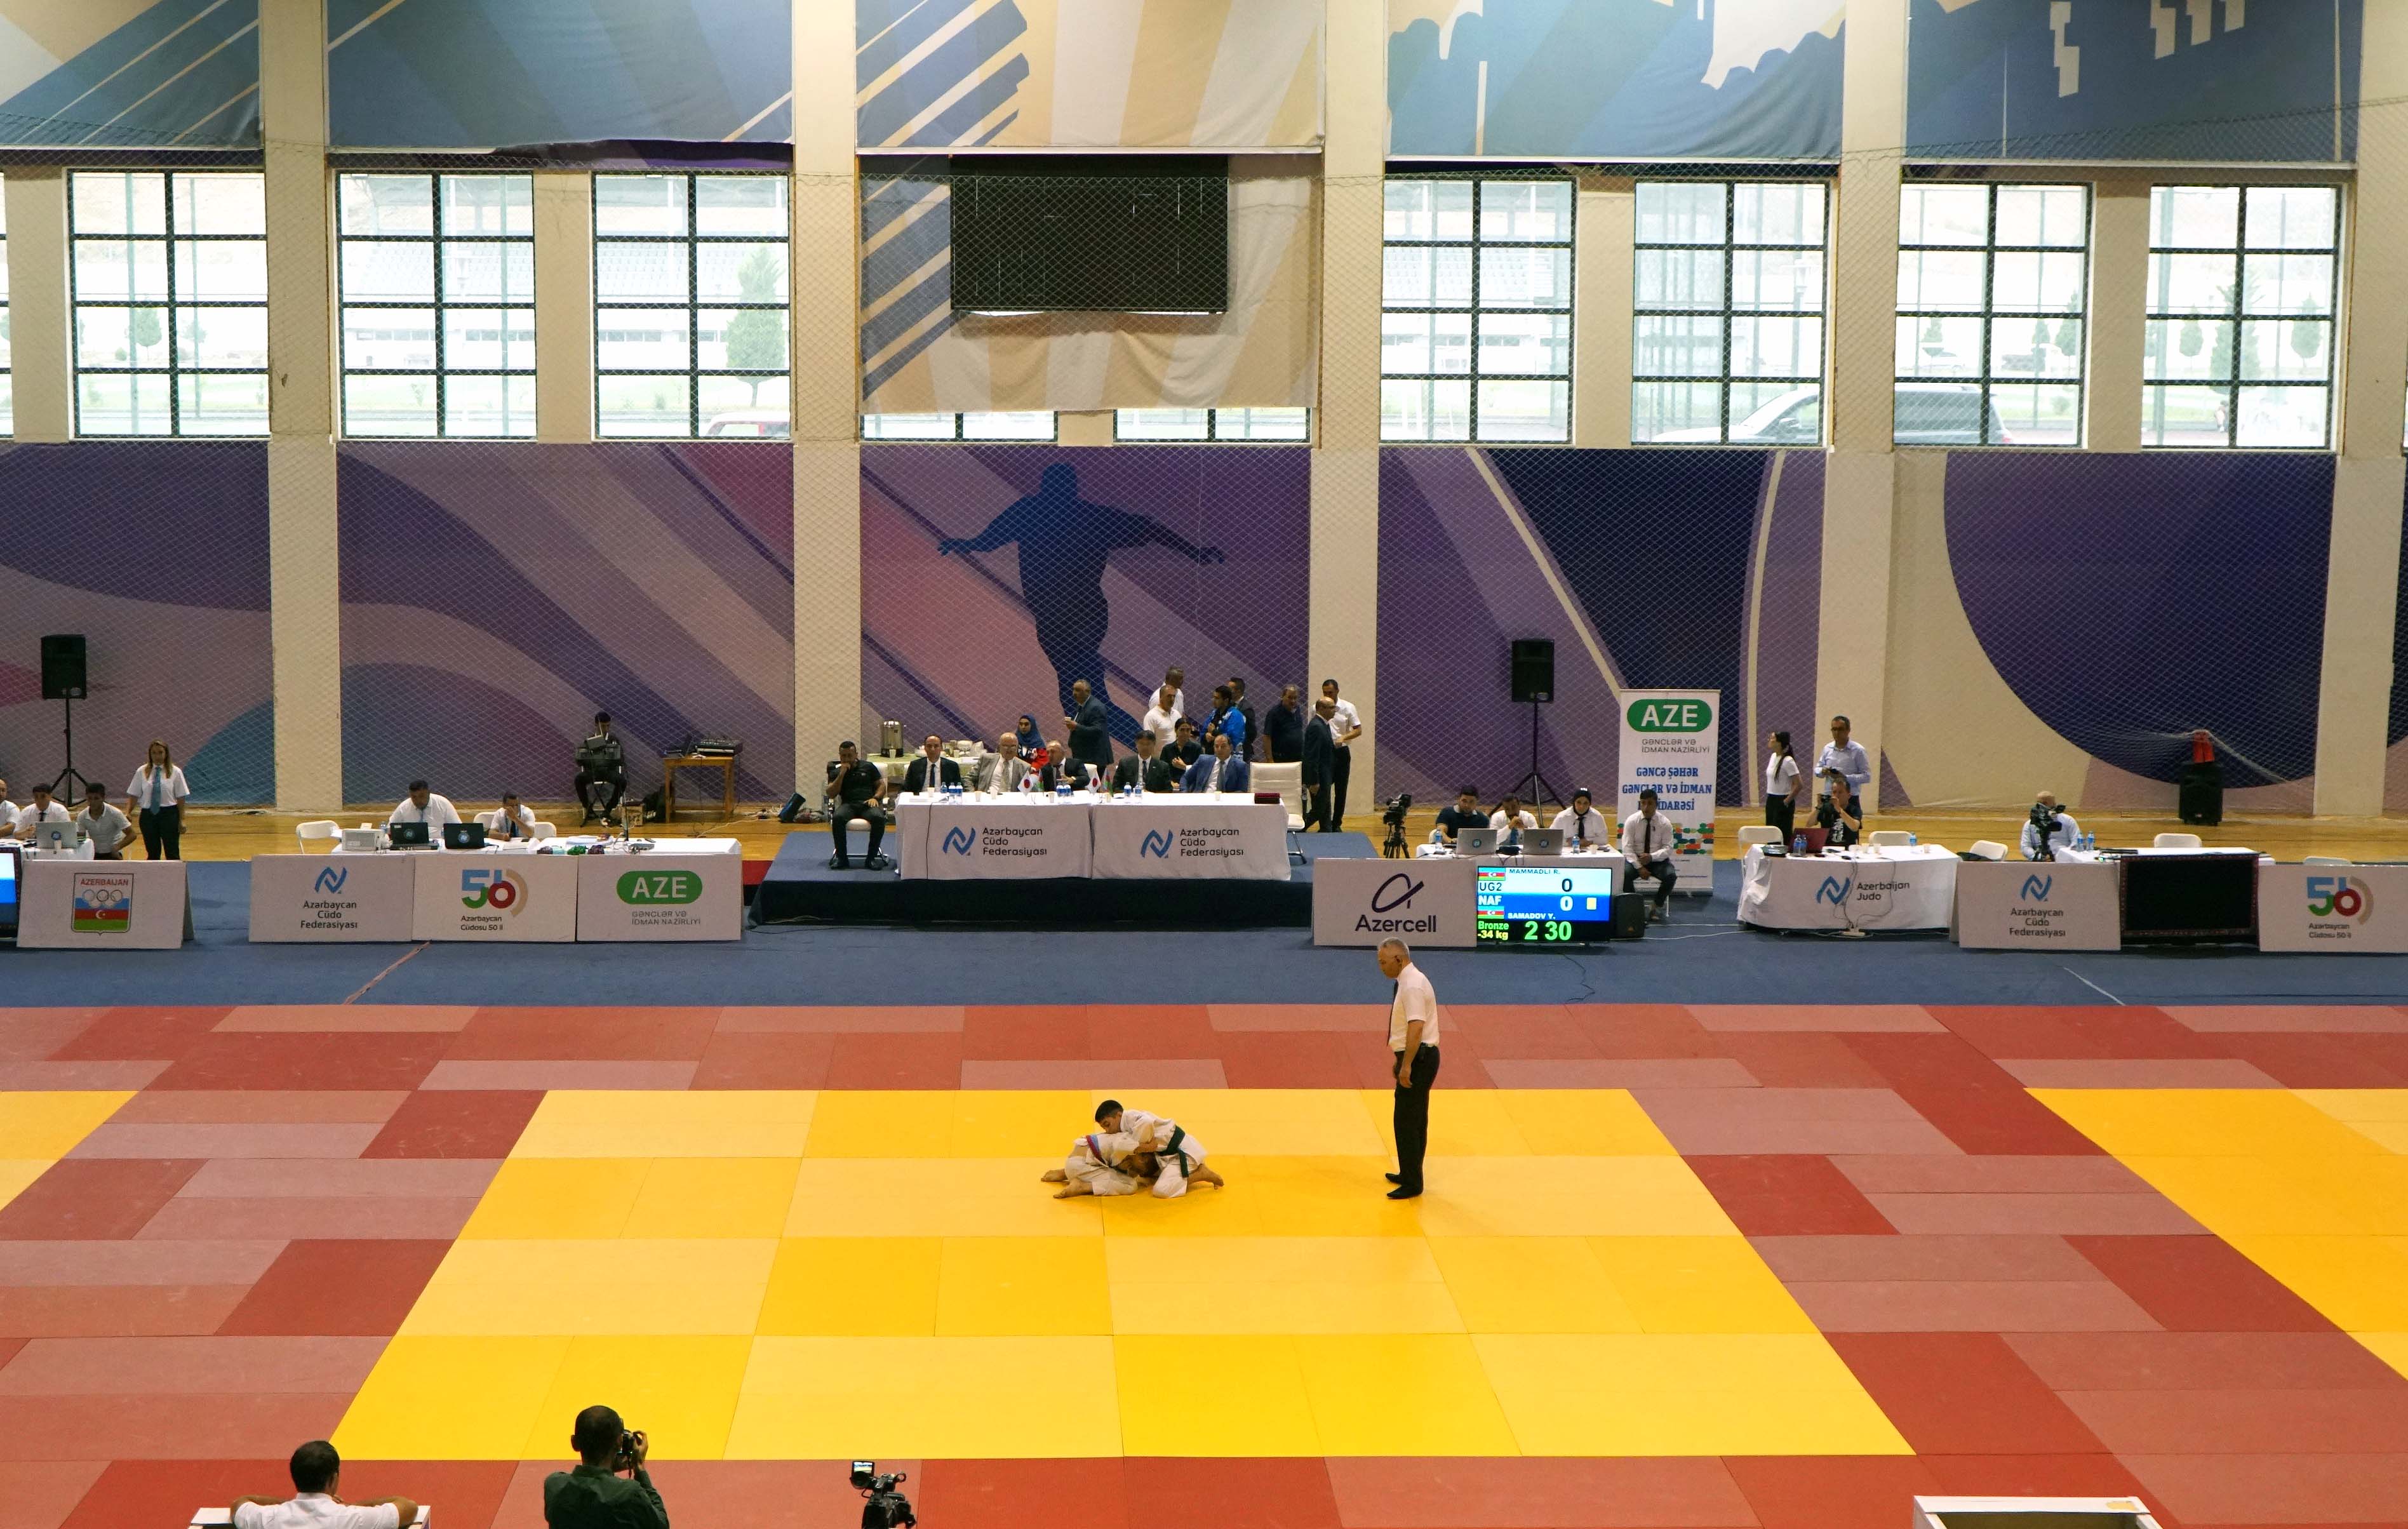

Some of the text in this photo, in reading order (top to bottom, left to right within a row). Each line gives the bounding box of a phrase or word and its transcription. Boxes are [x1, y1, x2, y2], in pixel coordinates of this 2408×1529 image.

[1641, 705, 1697, 727] AZE
[1636, 767, 1699, 780] GƏNCƏ ŞƏHƏR
[1666, 785, 1678, 793] VƏ
[1680, 782, 1712, 794] İDMAN
[982, 827, 1043, 838] Azərbaycan
[1180, 828, 1240, 838] Azərbaycan
[982, 837, 1008, 846] Cüdo
[1180, 838, 1206, 846] Cüdo
[983, 847, 1047, 858] Federasiyası
[1181, 848, 1244, 858] Federasiyası
[632, 877, 687, 898] AZE
[1480, 883, 1502, 891] UG2
[1562, 879, 1573, 892] 0
[1478, 895, 1502, 905] NAF
[1560, 895, 1574, 911] 0
[1354, 914, 1436, 932] Azercell
[1478, 921, 1509, 930] Bronze
[1478, 930, 1509, 940] -34 kg
